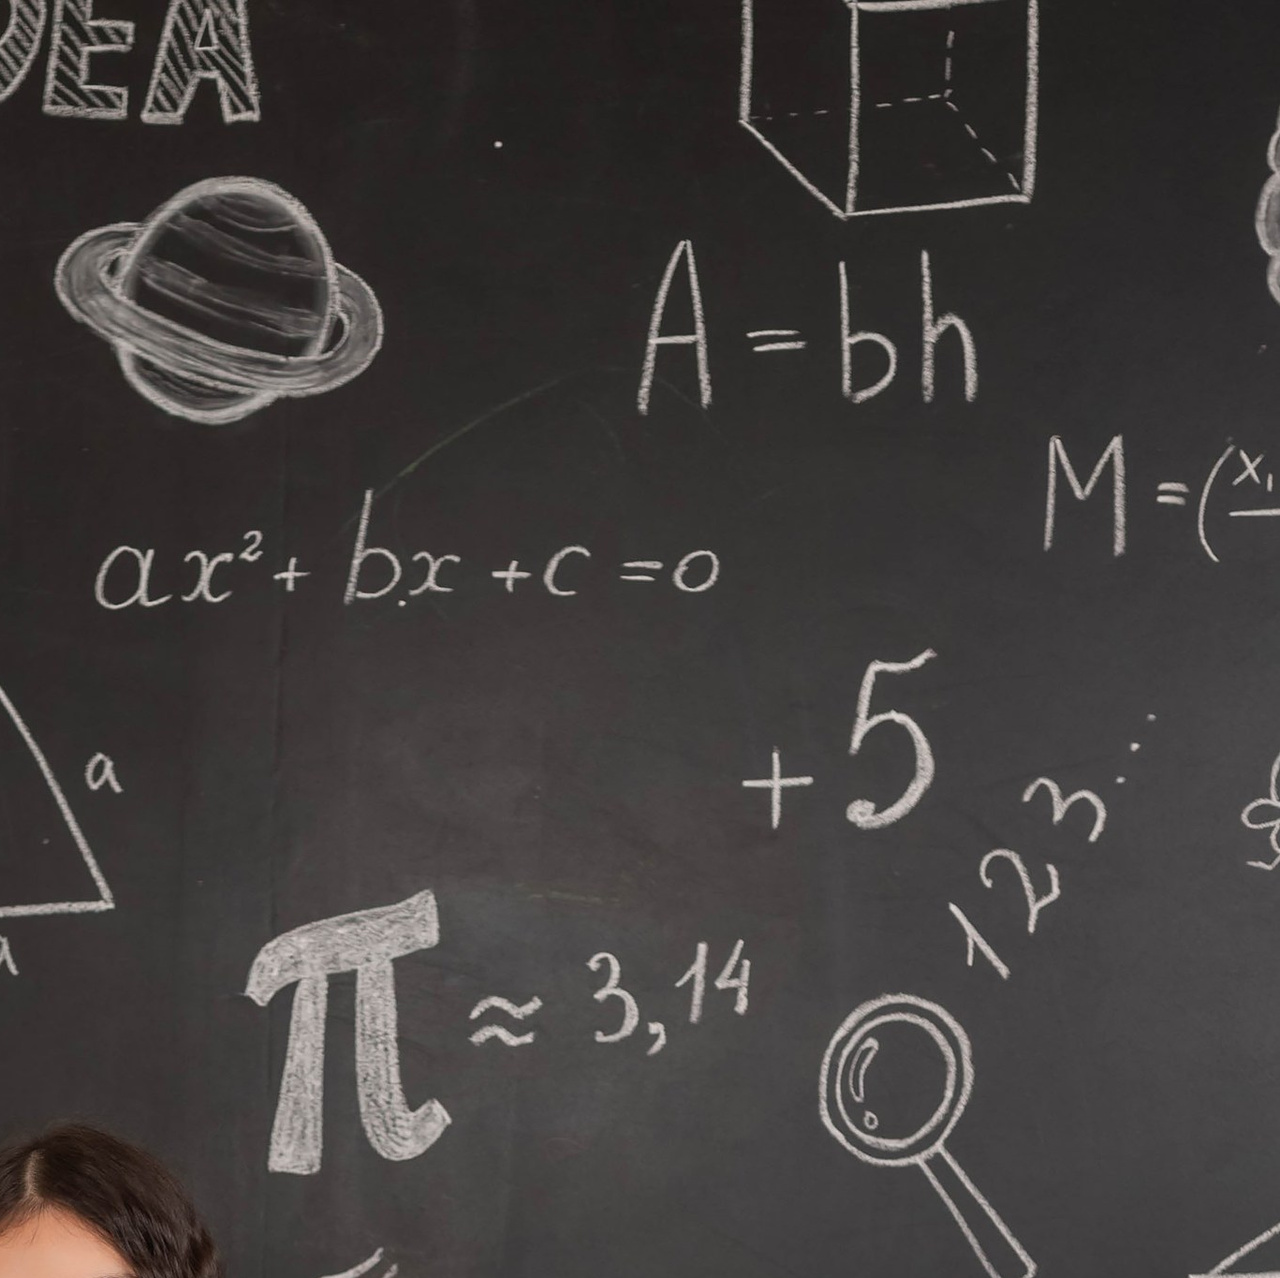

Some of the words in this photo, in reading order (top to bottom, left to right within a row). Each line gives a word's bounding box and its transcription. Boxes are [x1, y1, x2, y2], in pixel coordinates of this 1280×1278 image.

[638, 240, 711, 415] A
[839, 250, 977, 403] bh
[1045, 434, 1126, 557] M
[85, 752, 122, 793] a
[587, 940, 750, 1054] 3,14
